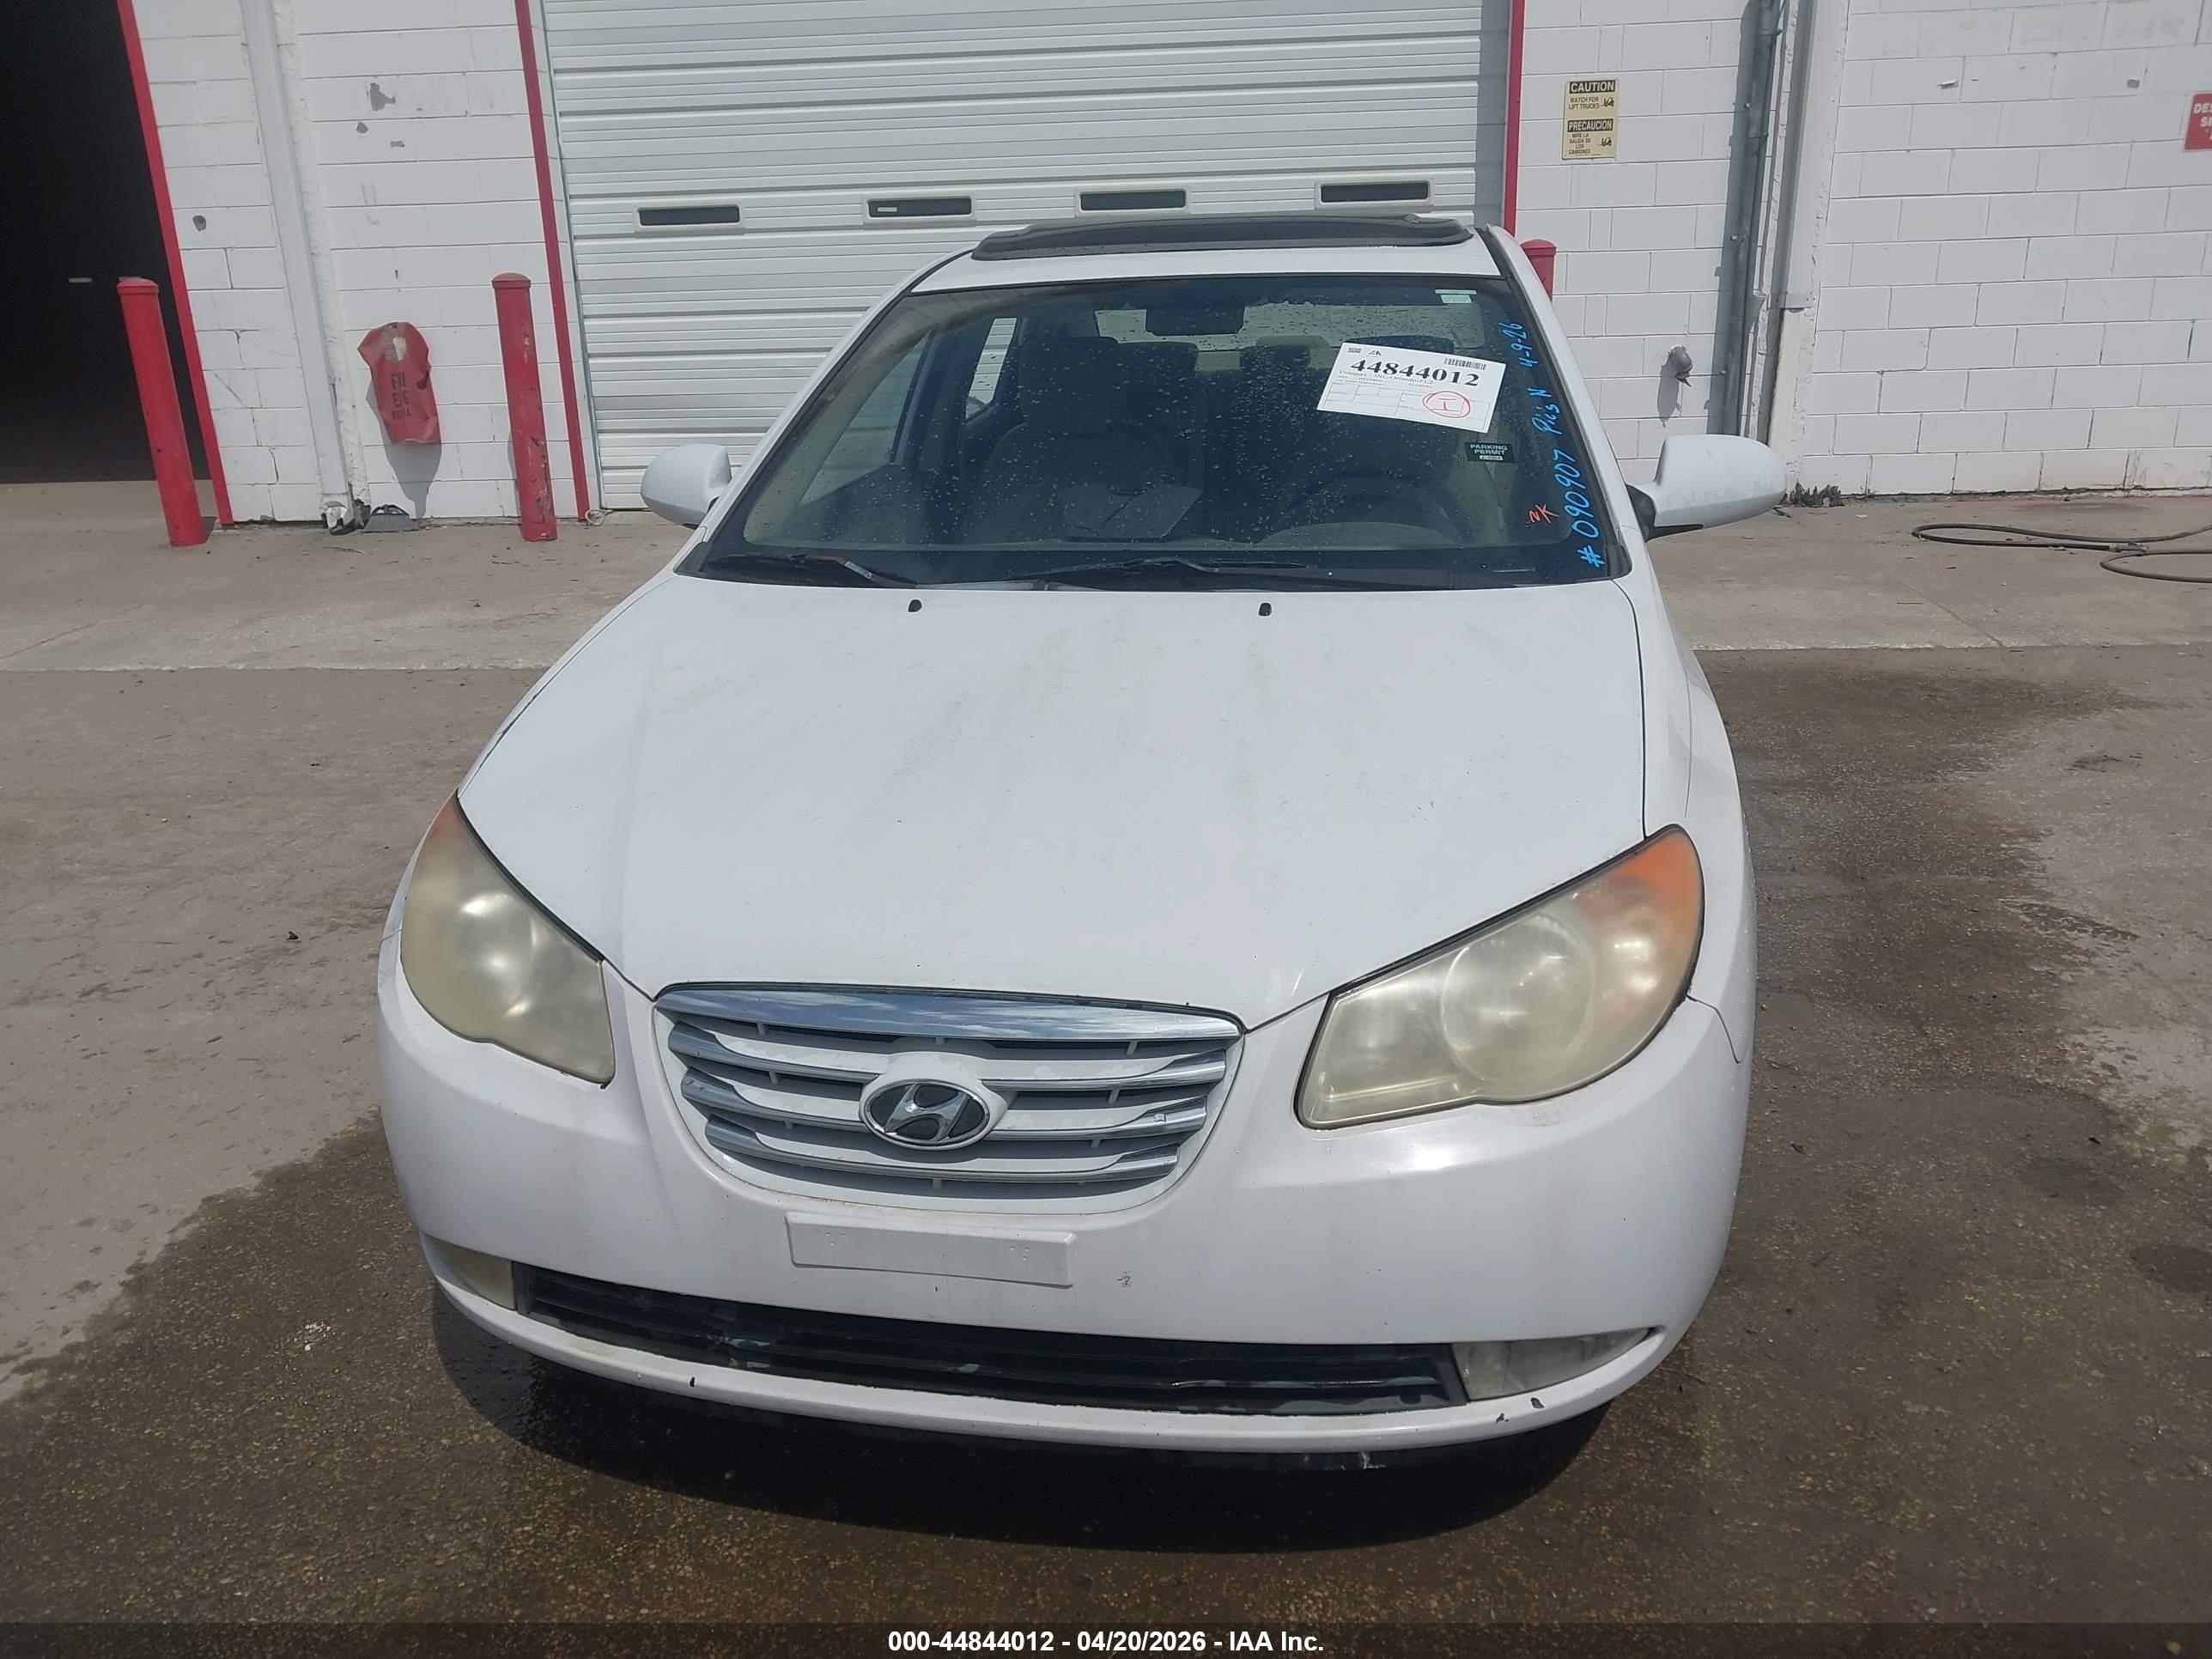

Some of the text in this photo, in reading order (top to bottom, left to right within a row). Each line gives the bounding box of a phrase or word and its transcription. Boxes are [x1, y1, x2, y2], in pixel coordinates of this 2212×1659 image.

[1571, 82, 1614, 92] CAUTION
[1568, 120, 1613, 131] PRECAUCION
[1498, 322, 1539, 368] 4-9-26
[1350, 359, 1480, 386] 44844012
